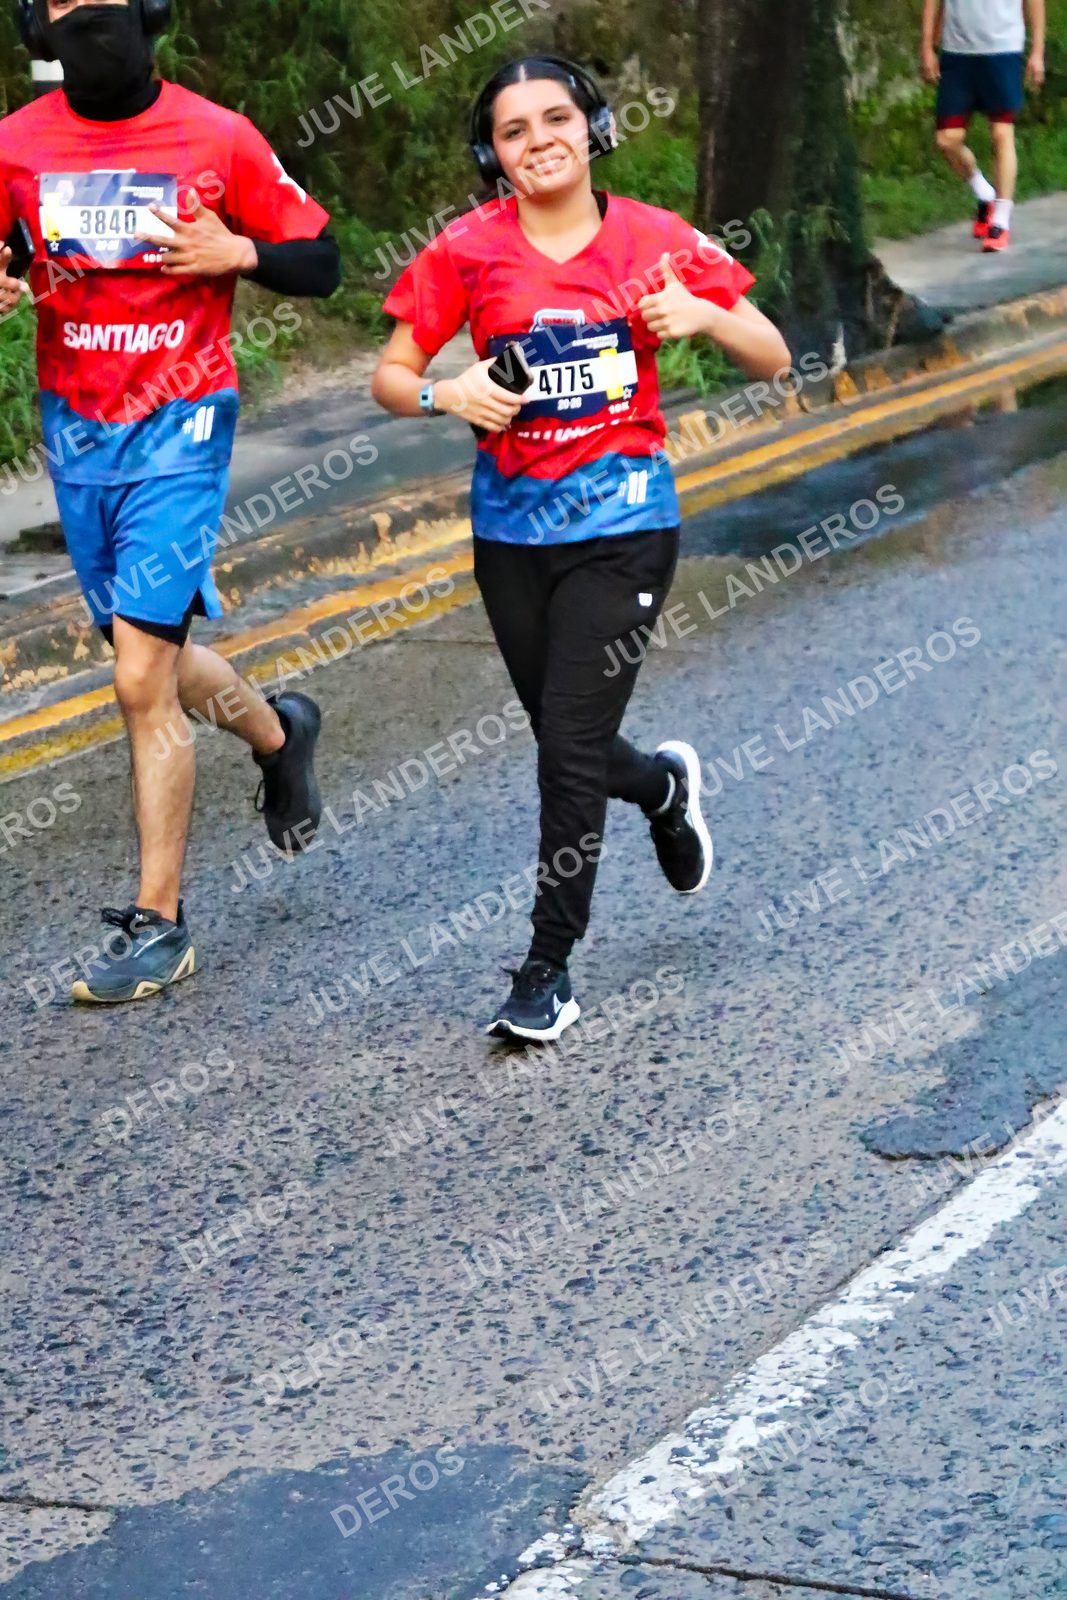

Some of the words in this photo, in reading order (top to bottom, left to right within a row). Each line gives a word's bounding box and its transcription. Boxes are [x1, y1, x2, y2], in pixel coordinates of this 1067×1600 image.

[80, 209, 136, 235] 3840
[63, 319, 185, 353] SANTIAGO
[539, 363, 594, 395] 4775
